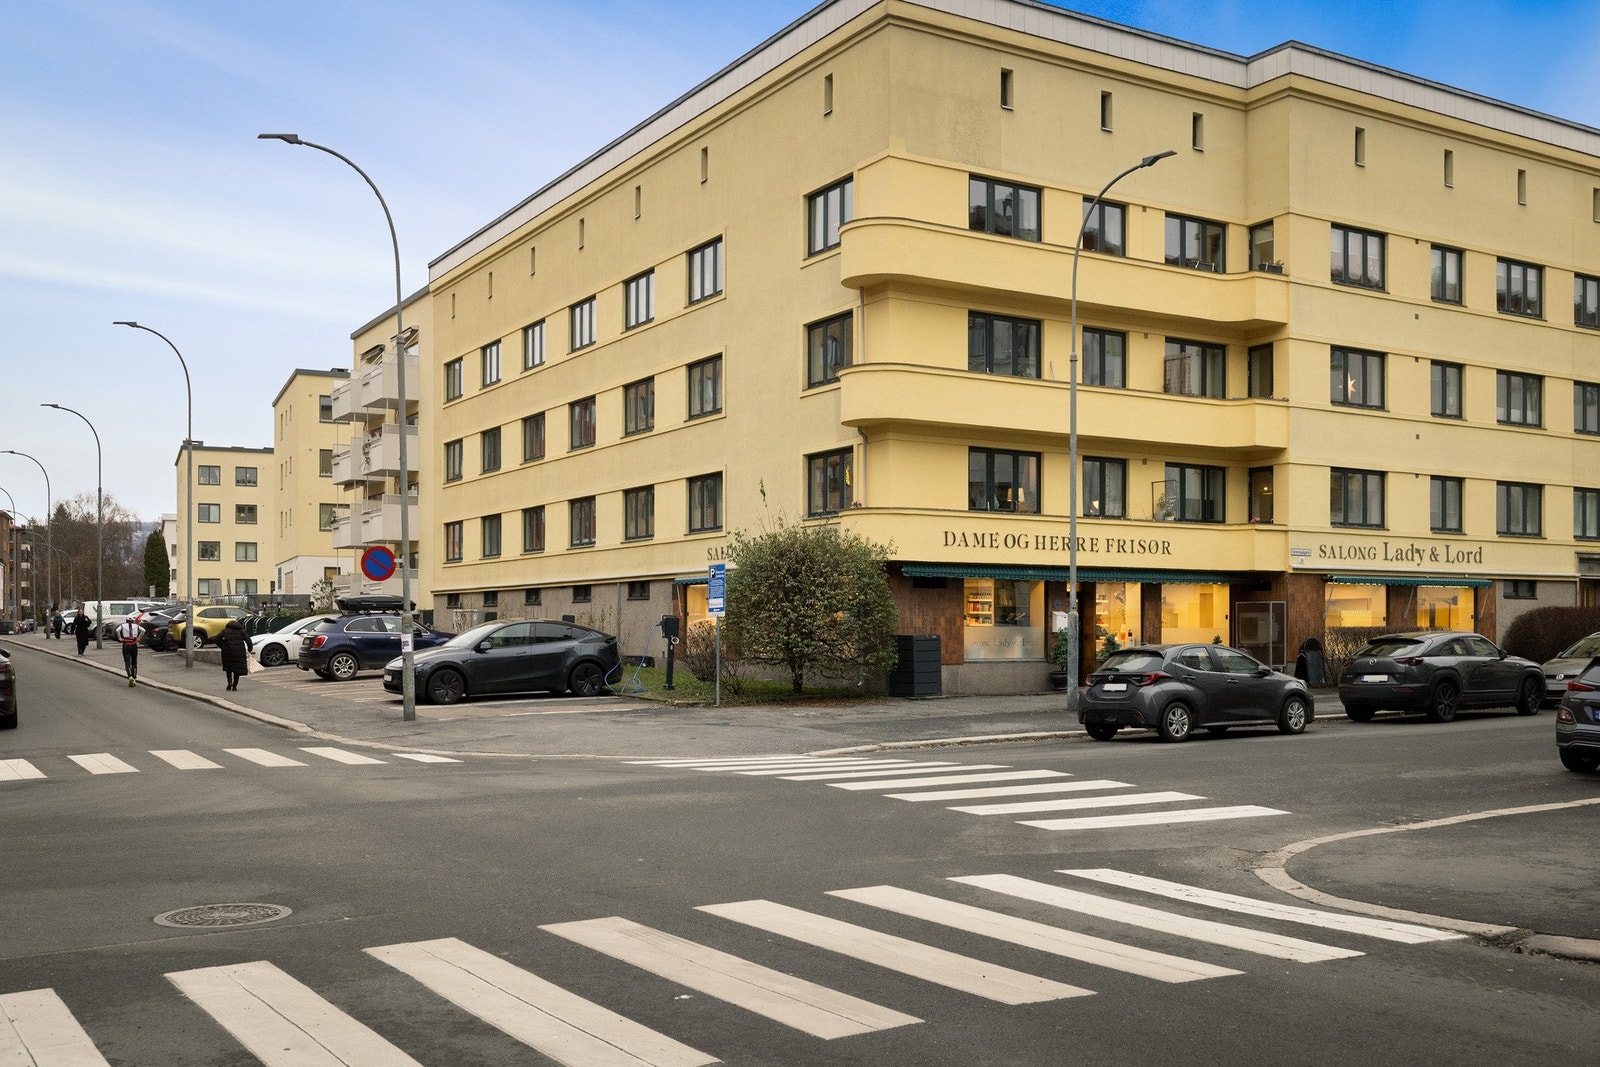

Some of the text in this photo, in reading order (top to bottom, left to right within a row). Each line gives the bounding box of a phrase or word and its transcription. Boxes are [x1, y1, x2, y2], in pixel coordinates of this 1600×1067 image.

[943, 530, 1172, 555] DAME OG HERRE FRISØR
[1318, 541, 1483, 566] SALONG Lady & Lord
